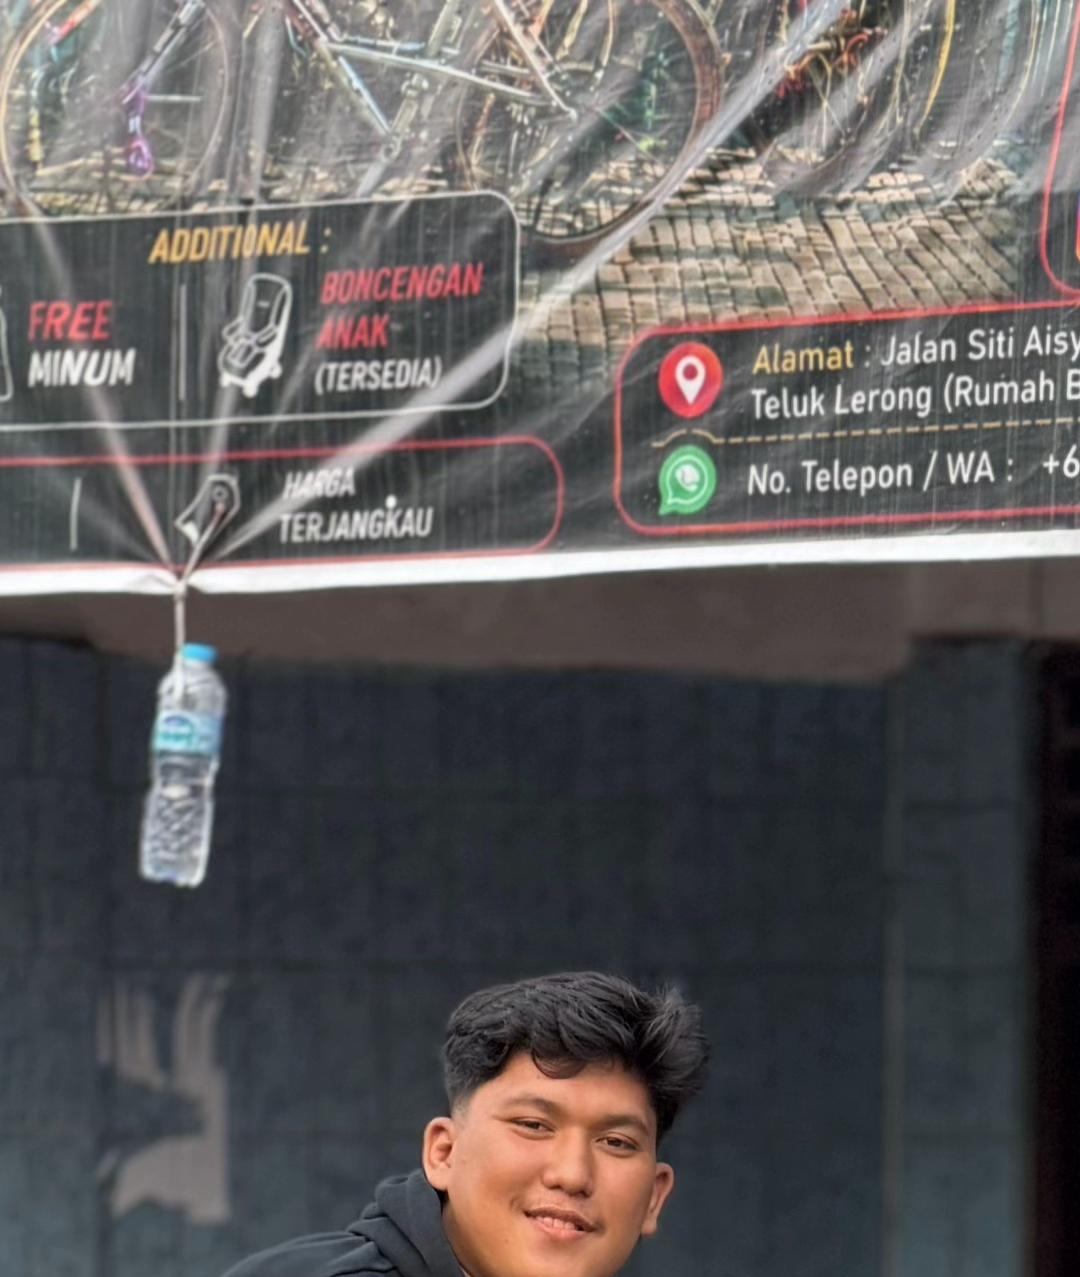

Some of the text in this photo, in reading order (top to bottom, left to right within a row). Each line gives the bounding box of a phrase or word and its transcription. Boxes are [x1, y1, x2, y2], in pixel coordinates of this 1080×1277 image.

[149, 226, 310, 264] ADDITIONAL
[321, 263, 484, 304] BONCENGAN
[28, 301, 113, 341] FREE
[315, 314, 391, 350] ANAK
[28, 348, 136, 388] MINUM
[752, 340, 854, 375] Alamat
[880, 331, 956, 367] Jalan
[968, 326, 1014, 361] Siti
[315, 356, 442, 394] (TERSEDIA)
[751, 384, 825, 419] Teluk
[834, 383, 932, 418] Lerong
[944, 370, 1055, 413] (Rumah
[281, 466, 356, 499] HARGA
[748, 463, 791, 495] No.
[801, 458, 913, 497] Telepon
[946, 451, 995, 484] WA
[279, 507, 435, 542] TERJANGKAU
